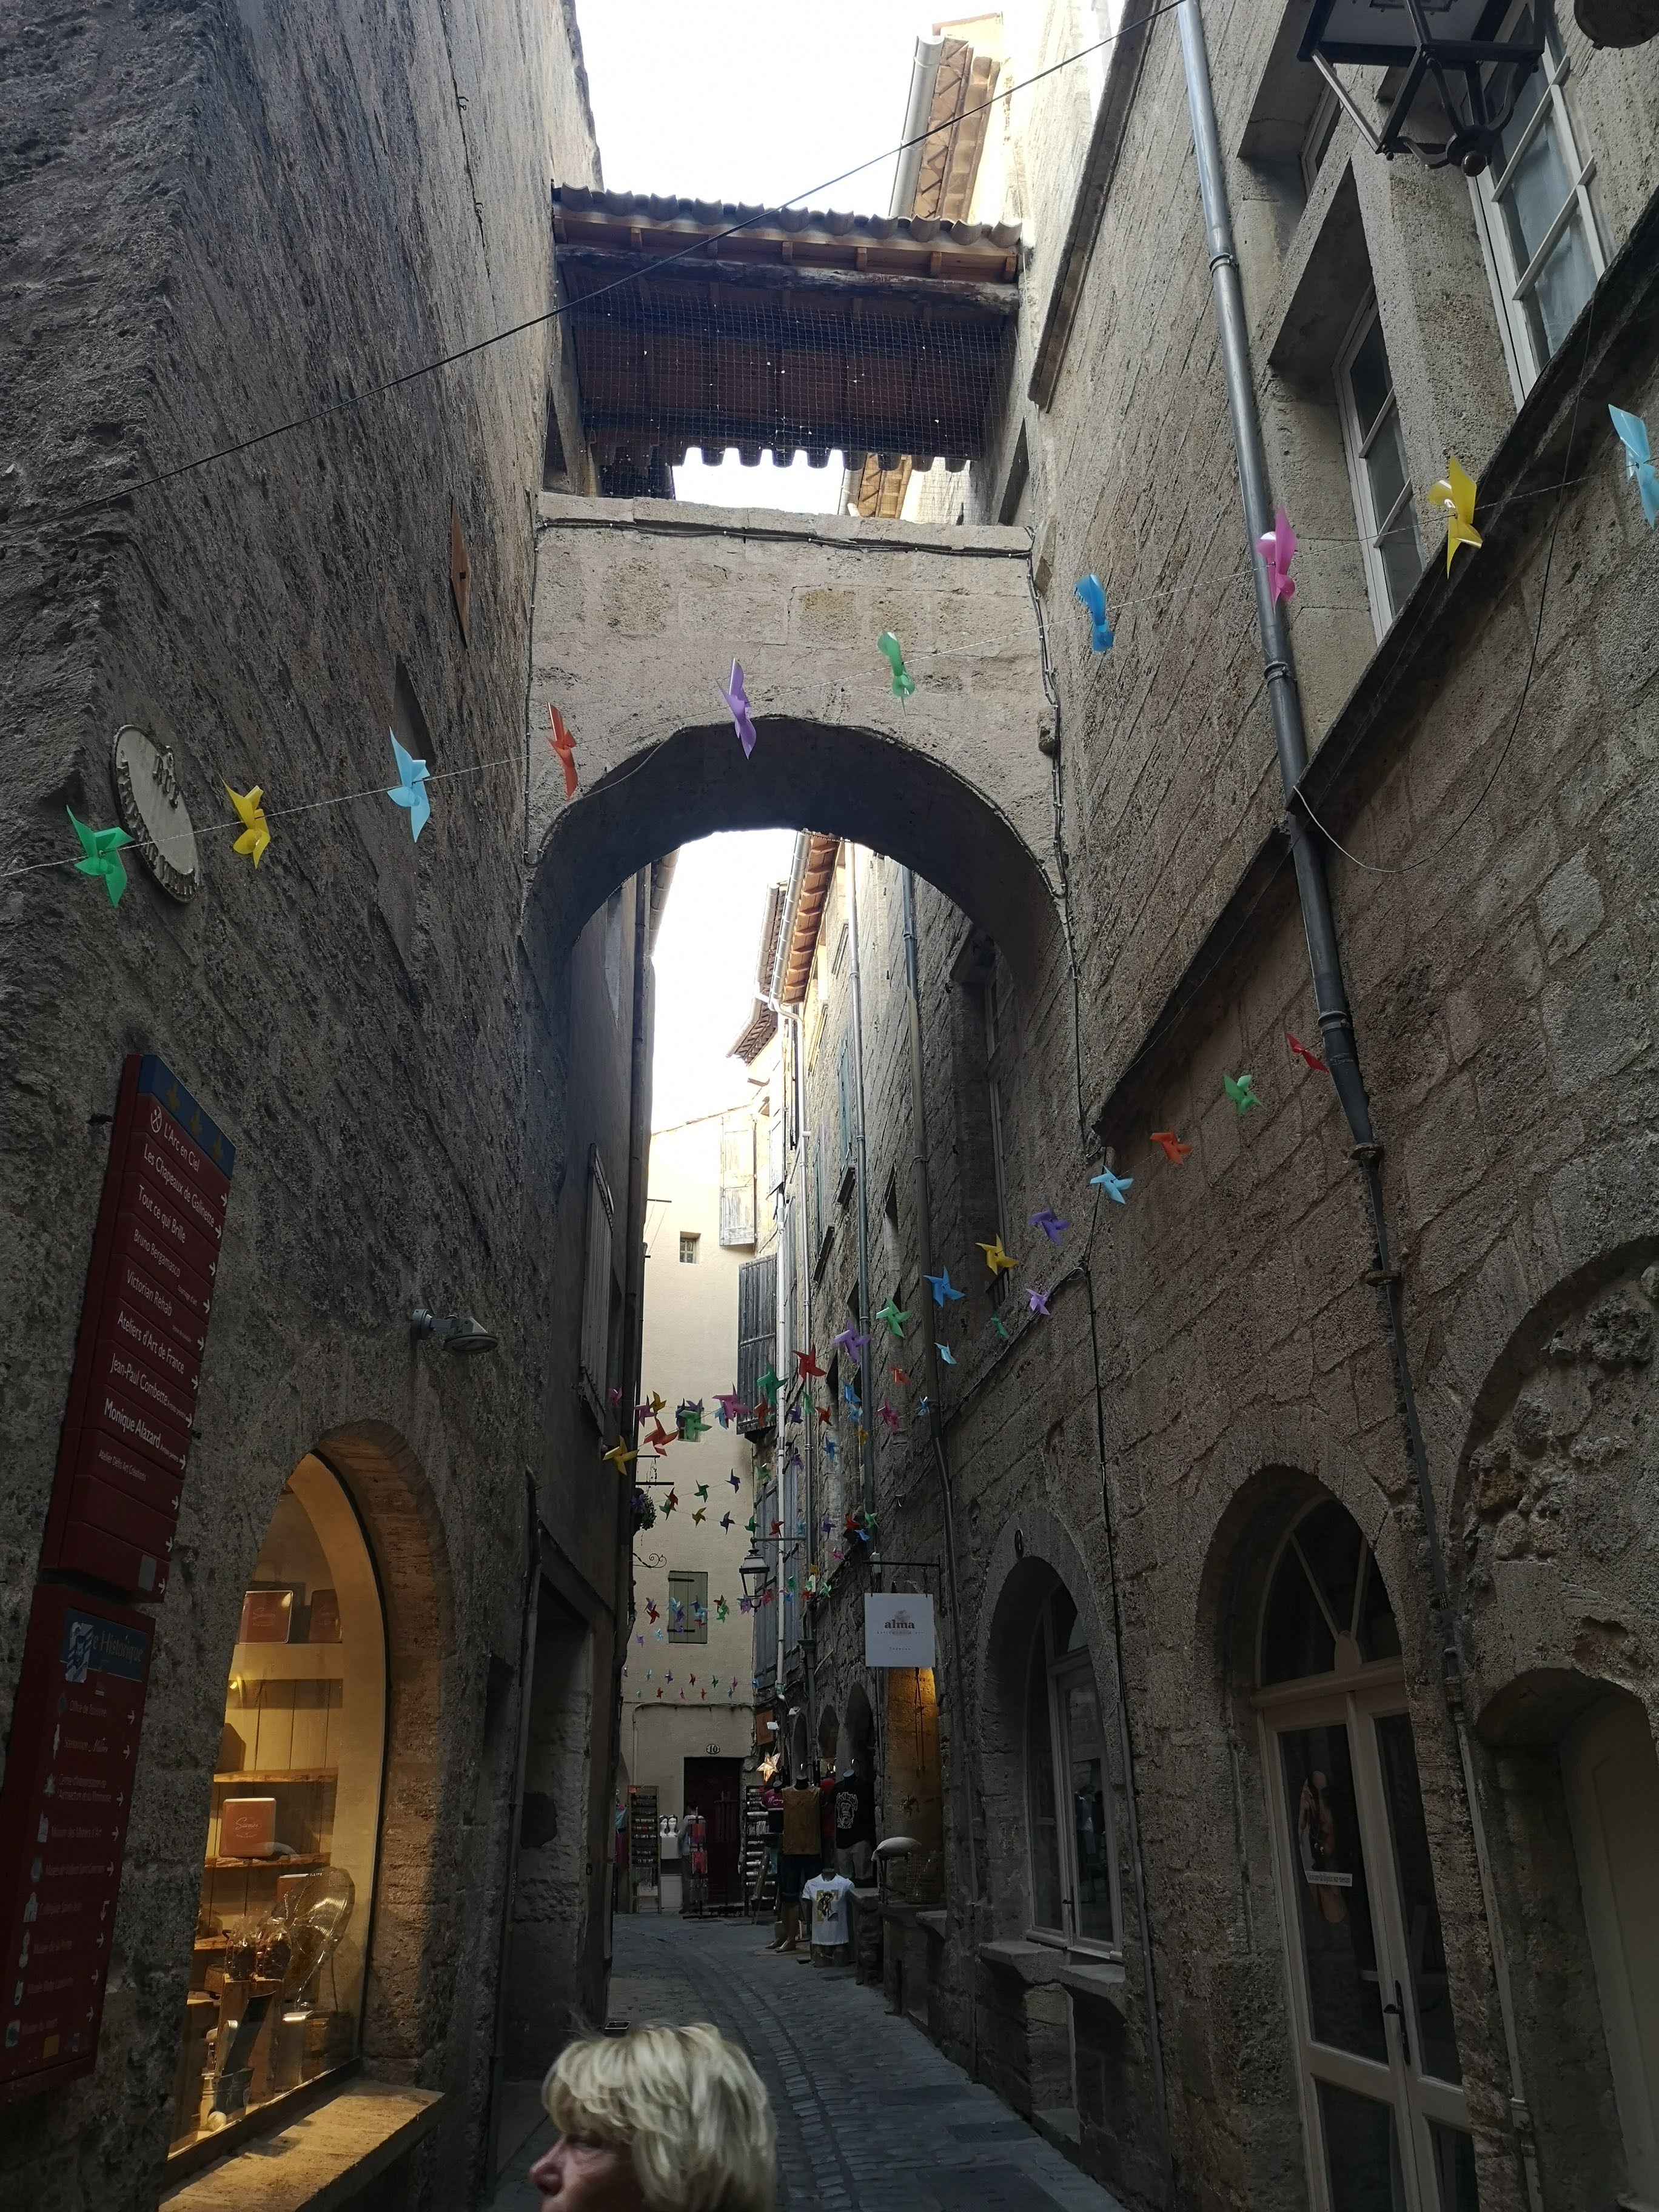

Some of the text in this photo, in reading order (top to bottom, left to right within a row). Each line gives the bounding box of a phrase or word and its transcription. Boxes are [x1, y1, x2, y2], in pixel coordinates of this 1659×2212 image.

[163, 1122, 200, 1173] L'Arc en Ciel
[143, 1143, 215, 1228] Les Chapeaux de Galinette
[139, 1184, 186, 1244] Tout ce qui Brille
[133, 1228, 181, 1278] Bruno Bergamasco
[127, 1269, 173, 1316] Victorian Rehab
[117, 1310, 142, 1342] Ateliers
[142, 1330, 159, 1355] d'Art
[158, 1342, 167, 1360] de
[166, 1347, 185, 1375] France
[110, 1353, 140, 1386] Jean-Paul
[139, 1374, 168, 1406] Combette
[104, 1398, 135, 1433] Monique
[135, 1419, 162, 1449] Alazard
[100, 1629, 144, 1664] Historique
[884, 1619, 915, 1629] alma
